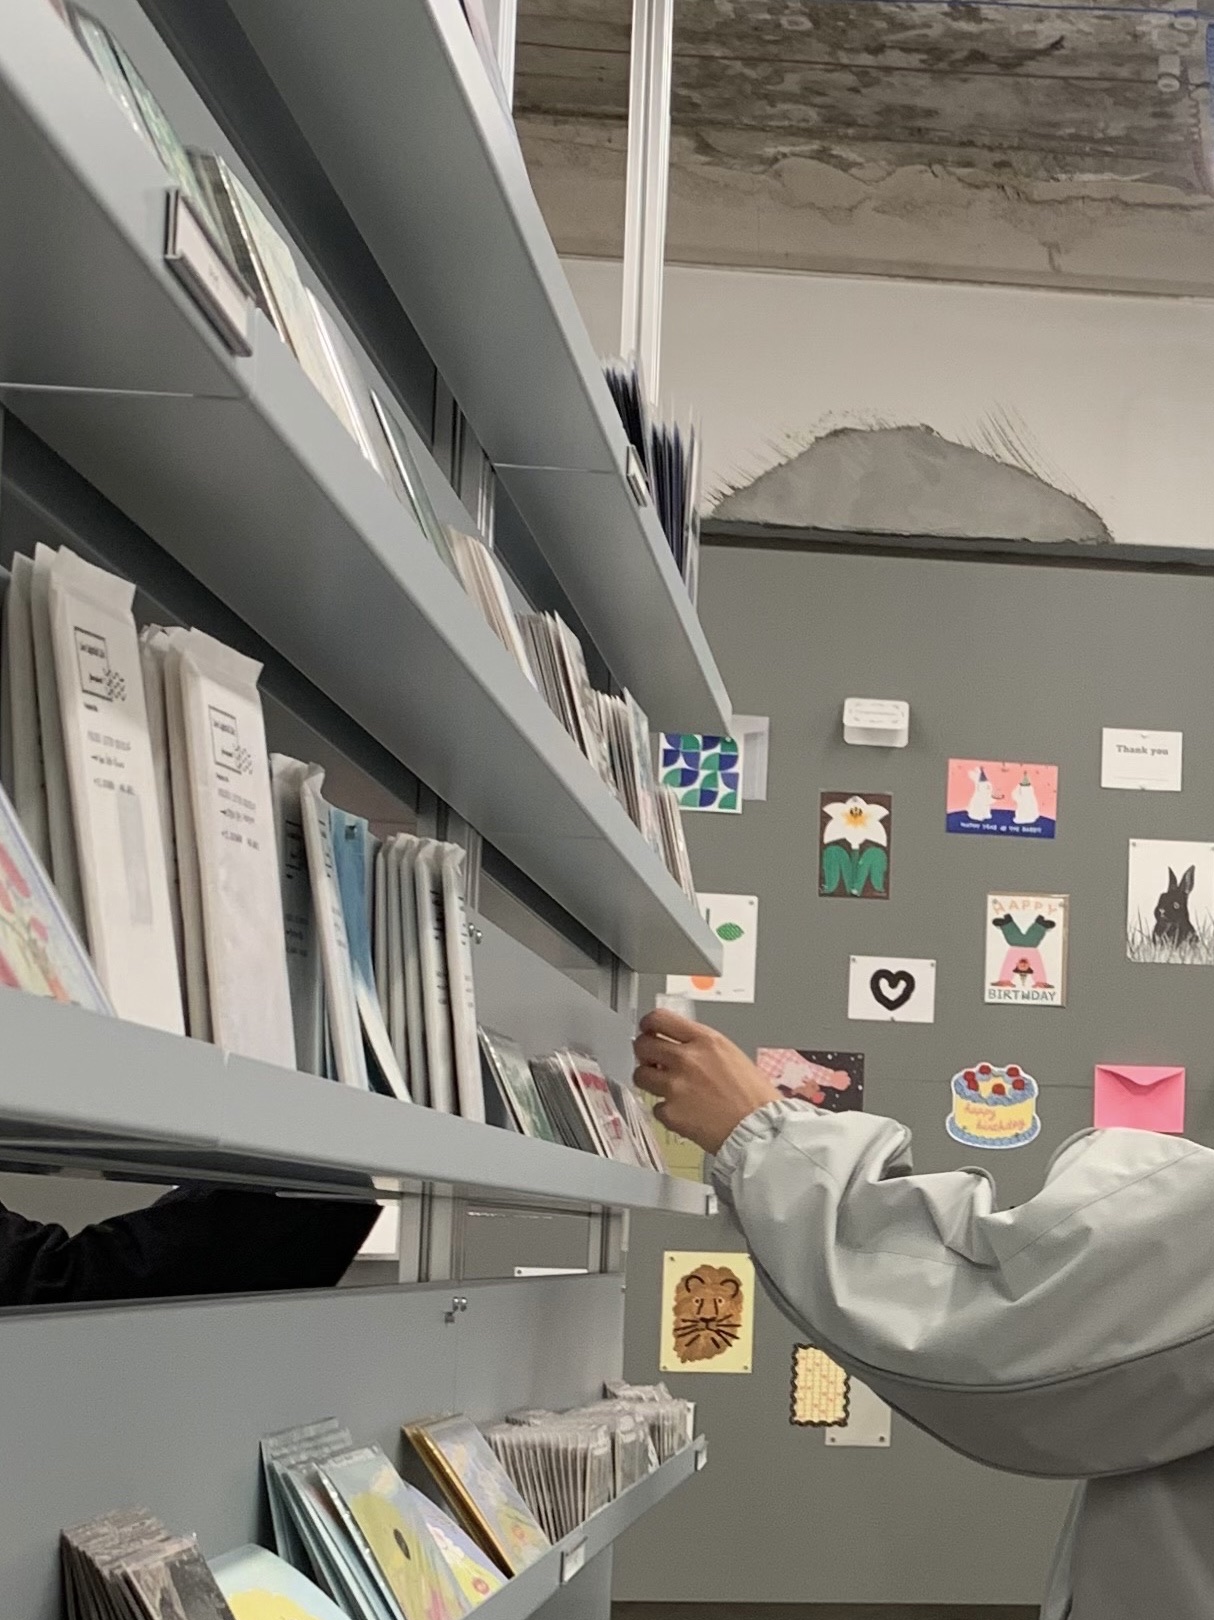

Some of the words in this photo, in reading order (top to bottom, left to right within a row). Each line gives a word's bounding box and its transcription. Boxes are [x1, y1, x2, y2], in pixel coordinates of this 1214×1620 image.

[1116, 744, 1148, 754] Thank
[1150, 748, 1169, 756] you
[991, 900, 1057, 914] HAPPY
[988, 989, 1056, 1002] BIRTHDAY
